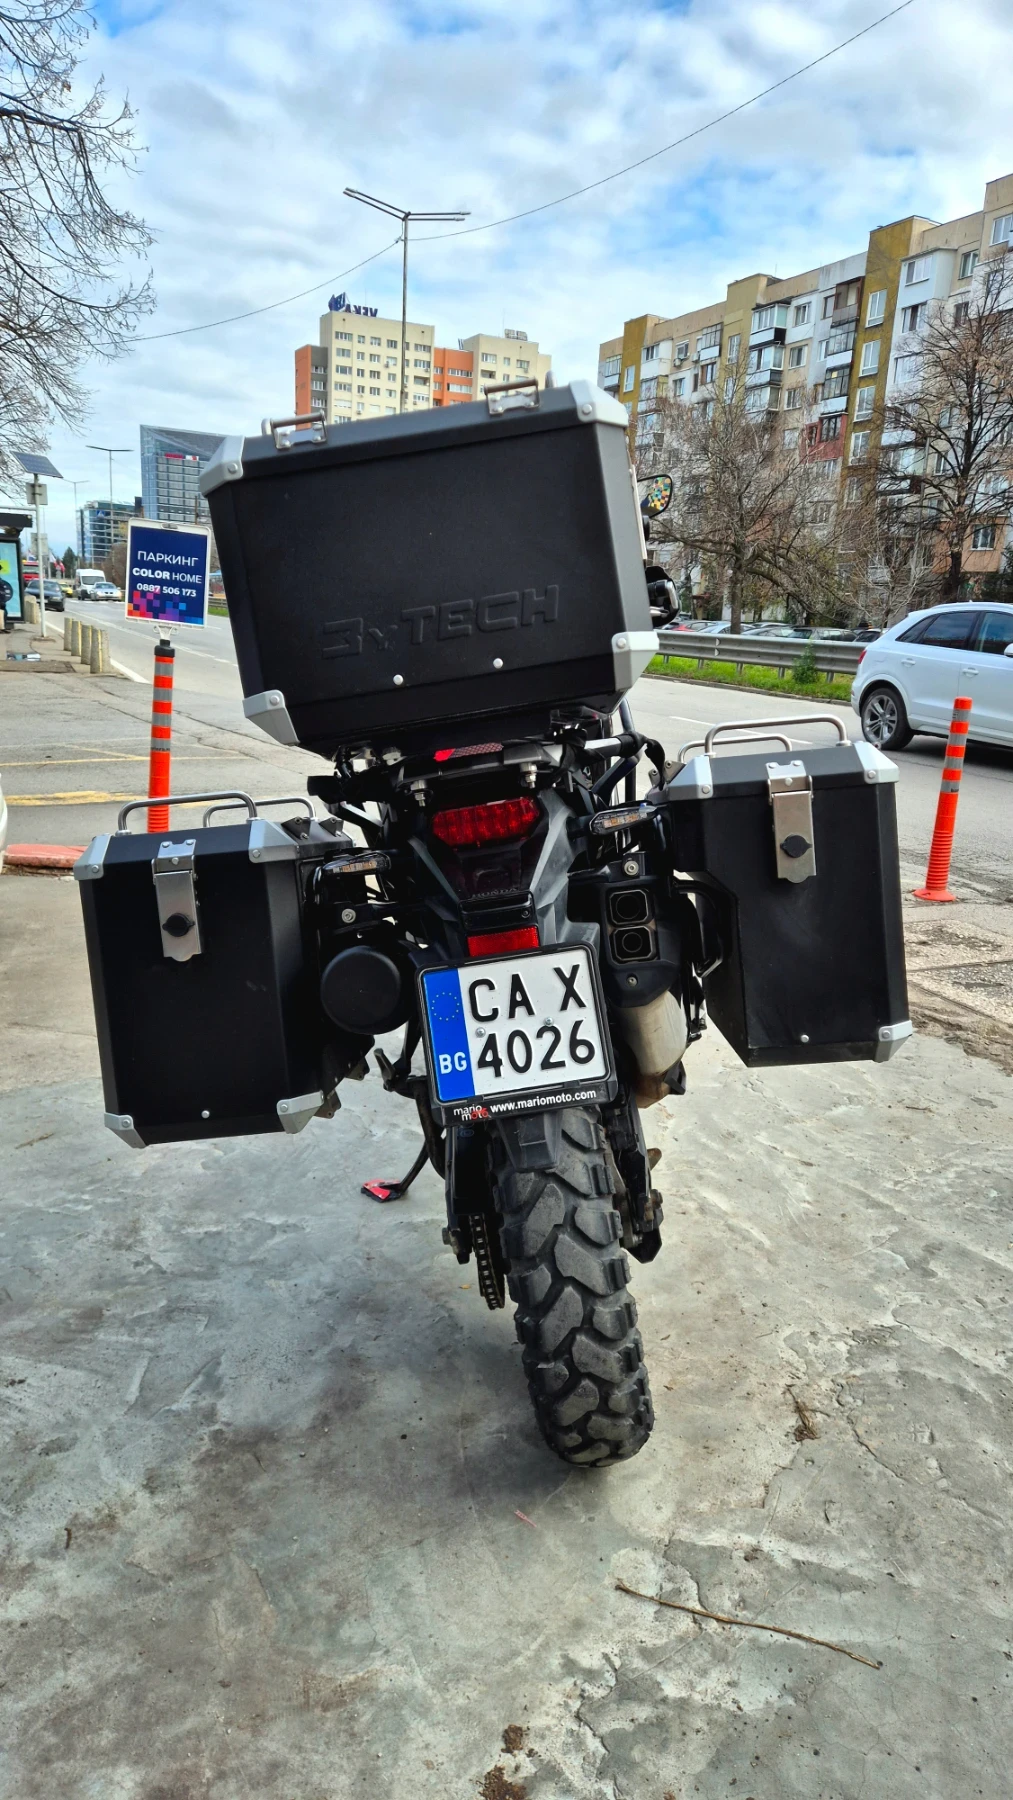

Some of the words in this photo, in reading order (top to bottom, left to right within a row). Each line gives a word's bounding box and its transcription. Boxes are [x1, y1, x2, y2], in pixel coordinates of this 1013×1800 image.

[137, 550, 199, 567] ПАРКИНГ
[132, 567, 170, 580] COLOR
[172, 572, 203, 584] HOME
[136, 582, 161, 593] 0887
[162, 586, 180, 595] 506
[182, 588, 197, 597] 173
[468, 973, 535, 1022] CA
[553, 963, 587, 1012] X
[477, 1019, 596, 1078] 4026
[438, 1051, 468, 1075] BG
[453, 1103, 483, 1116] mario
[489, 1089, 597, 1113] www.mariomoto.com
